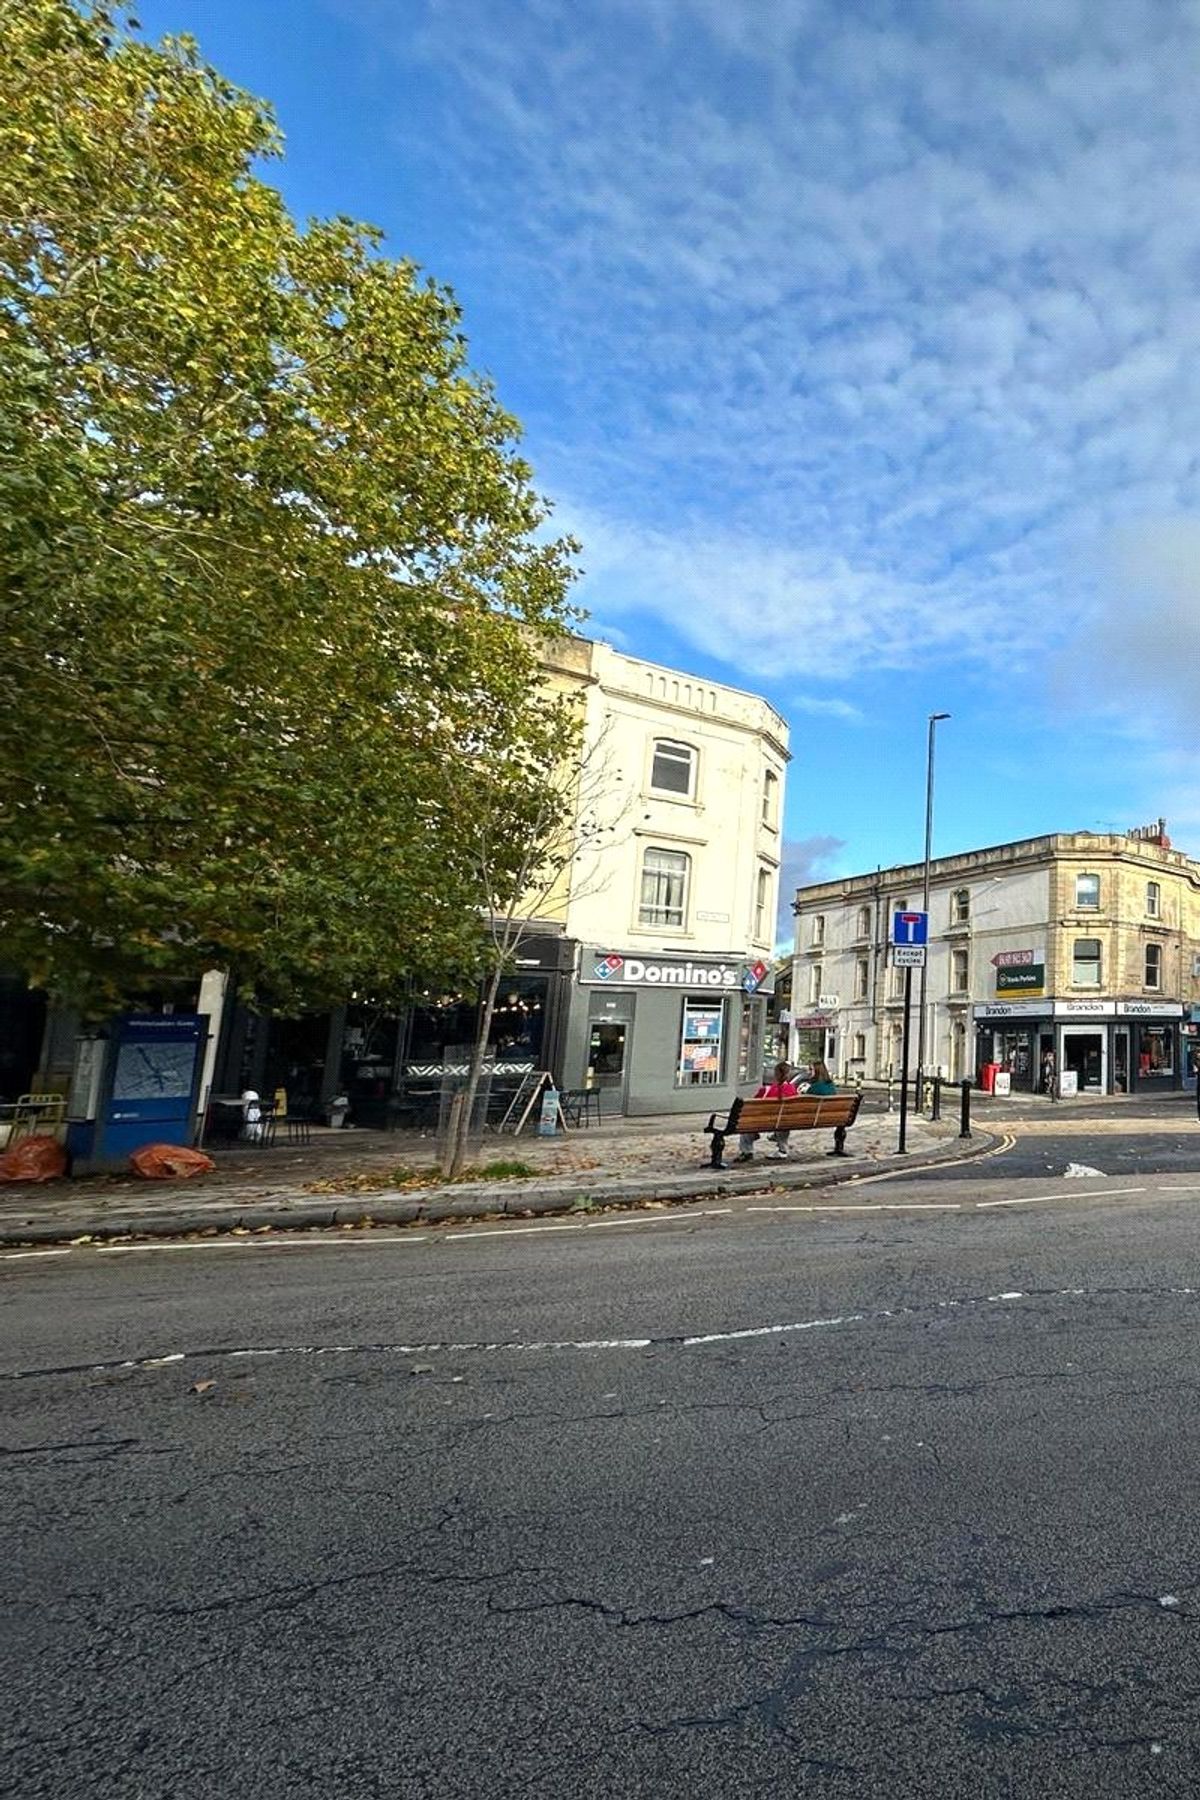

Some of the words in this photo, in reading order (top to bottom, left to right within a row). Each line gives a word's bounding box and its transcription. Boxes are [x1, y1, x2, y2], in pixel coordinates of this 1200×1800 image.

[623, 960, 738, 985] Domino's
[1066, 1003, 1104, 1011] Brandon
[1123, 1003, 1152, 1014] Brandon
